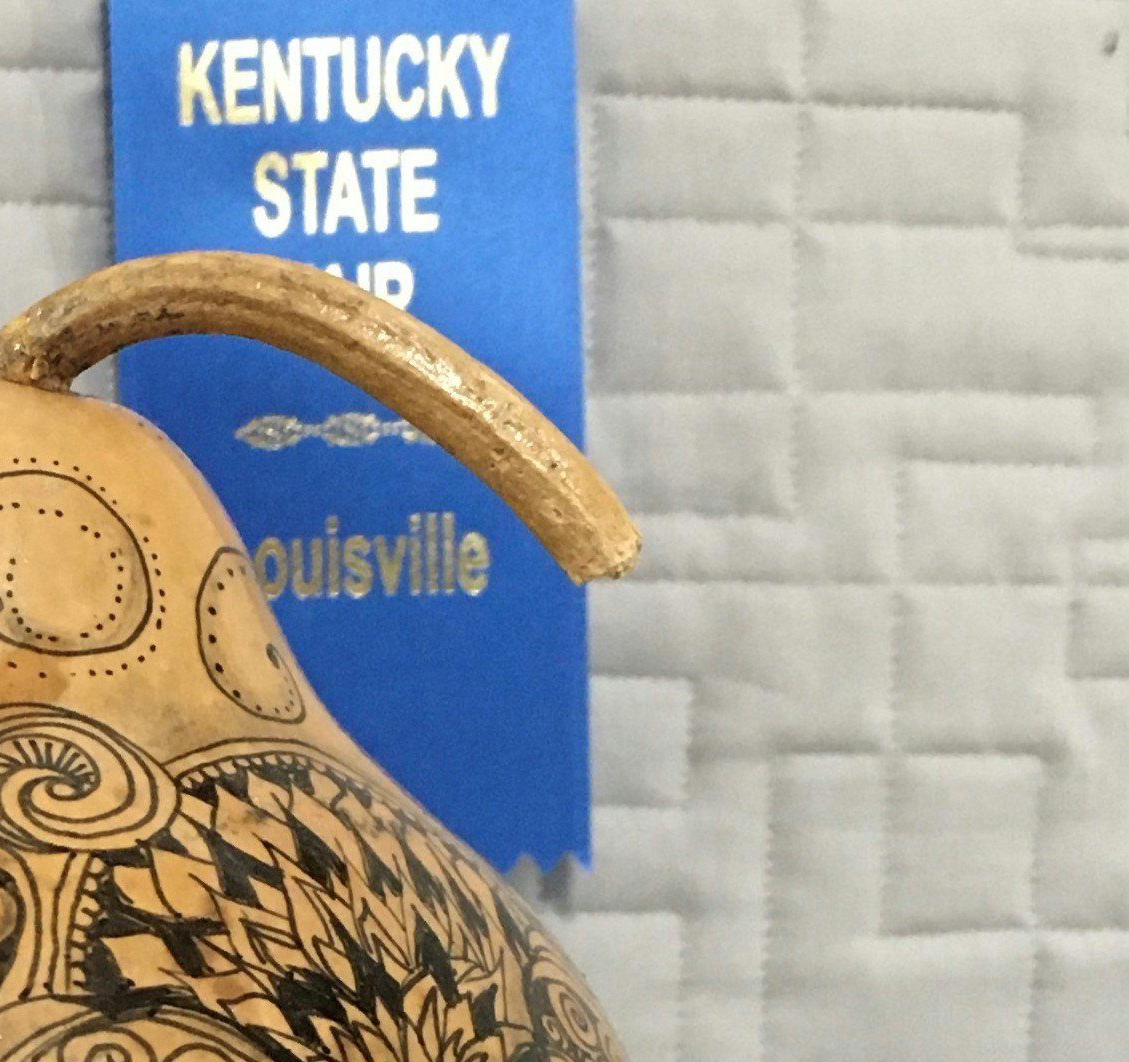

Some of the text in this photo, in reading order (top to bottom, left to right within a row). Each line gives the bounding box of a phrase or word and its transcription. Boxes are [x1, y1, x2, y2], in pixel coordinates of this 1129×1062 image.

[178, 33, 510, 126] KENTUCKY
[251, 148, 440, 238] STATE
[253, 511, 490, 599] ouisville
